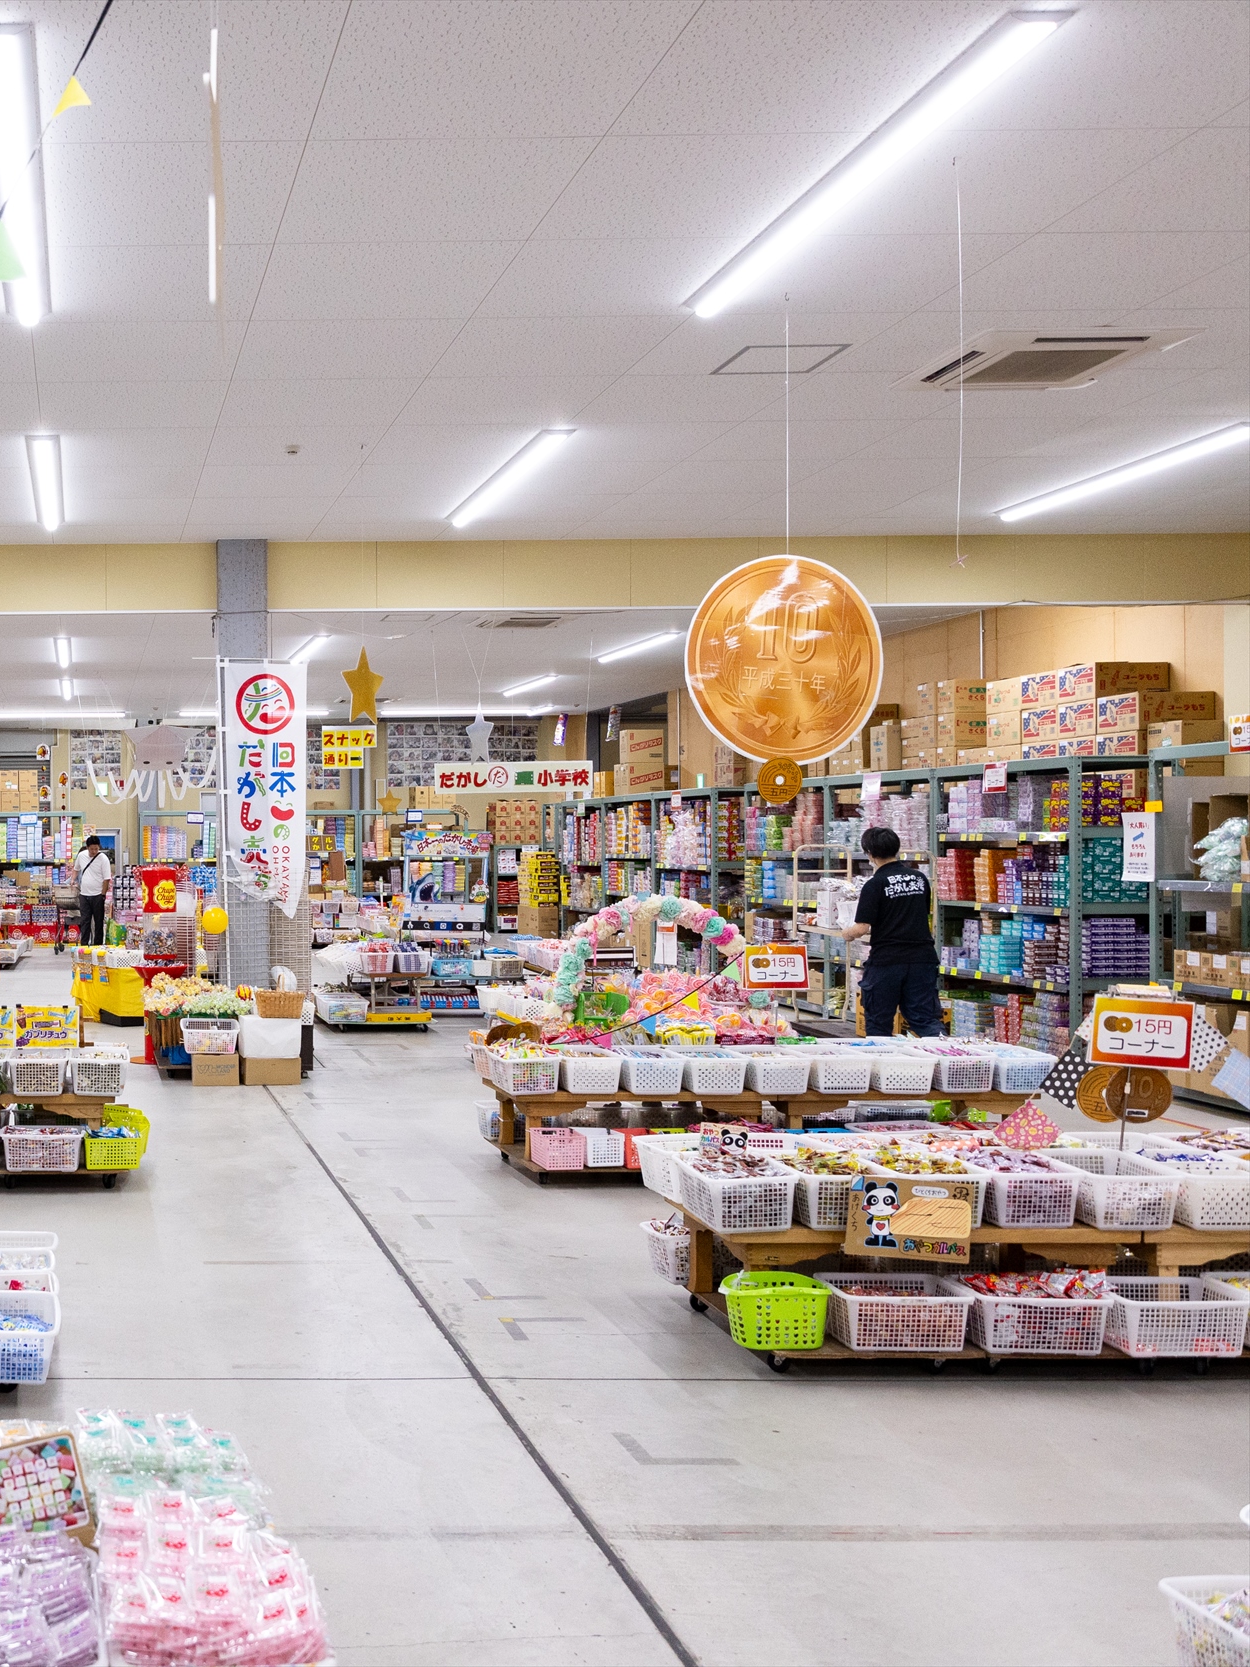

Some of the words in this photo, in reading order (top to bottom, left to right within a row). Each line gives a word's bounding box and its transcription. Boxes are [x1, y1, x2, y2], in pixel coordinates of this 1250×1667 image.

[755, 590, 820, 664] 10
[742, 666, 827, 695] 平成三十年
[323, 732, 375, 745] スナック
[324, 754, 349, 765] 通り
[439, 771, 488, 788] だがし
[537, 769, 590, 787] 小学校
[770, 787, 789, 797] 五円
[417, 832, 480, 856] 日本一のだがし売場
[771, 957, 796, 968] 15円
[757, 970, 799, 981] コーナー
[1134, 1018, 1173, 1035] 15円
[25, 1030, 68, 1040] ガブリチュウ
[1109, 1037, 1175, 1053] コーナー
[915, 1187, 947, 1196] ひとくちおやつ
[903, 1238, 967, 1256] おやつカルパス
